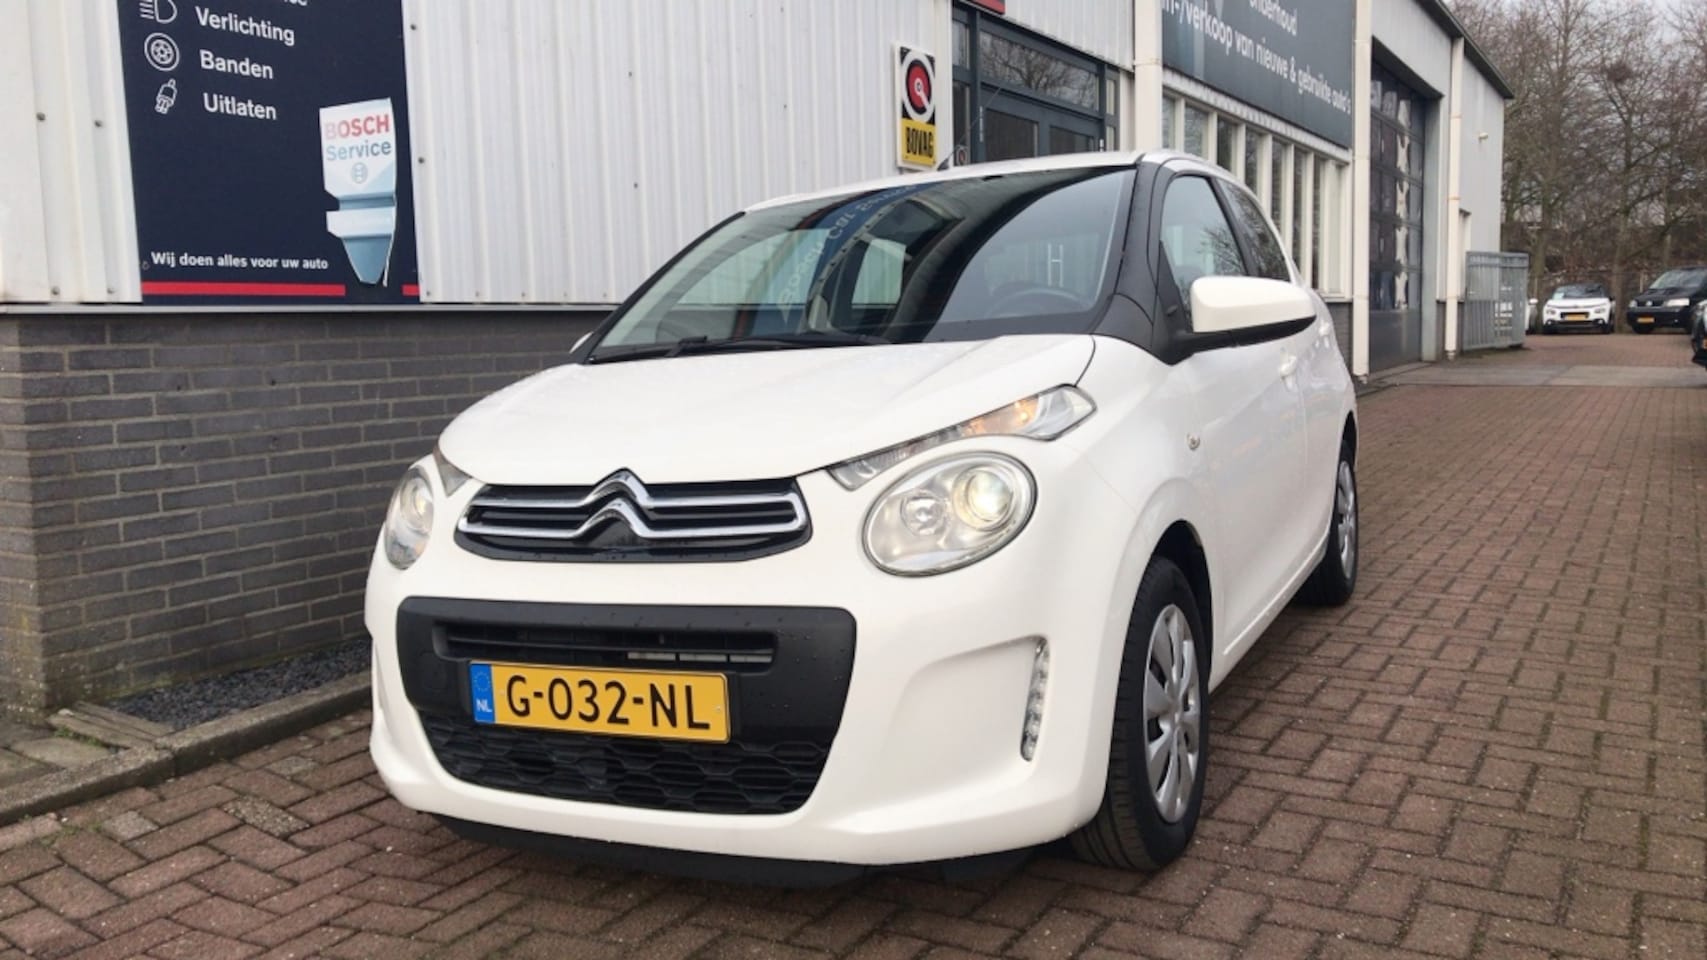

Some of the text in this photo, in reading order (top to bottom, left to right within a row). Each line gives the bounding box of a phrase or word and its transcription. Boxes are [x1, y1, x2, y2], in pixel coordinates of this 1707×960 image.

[195, 6, 295, 46] Verlichting
[199, 49, 273, 79] Banden
[1235, 31, 1254, 60] van
[1257, 37, 1288, 79] nieuwe
[1290, 55, 1297, 83] &
[203, 92, 277, 120] Uitlaten
[325, 114, 389, 140] BOSCH
[326, 140, 392, 161] Service
[905, 126, 935, 158] BOVAG
[151, 251, 329, 269] Wij doen alles voor uw auto
[476, 699, 492, 713] NL
[506, 674, 711, 730] G-032-NL
